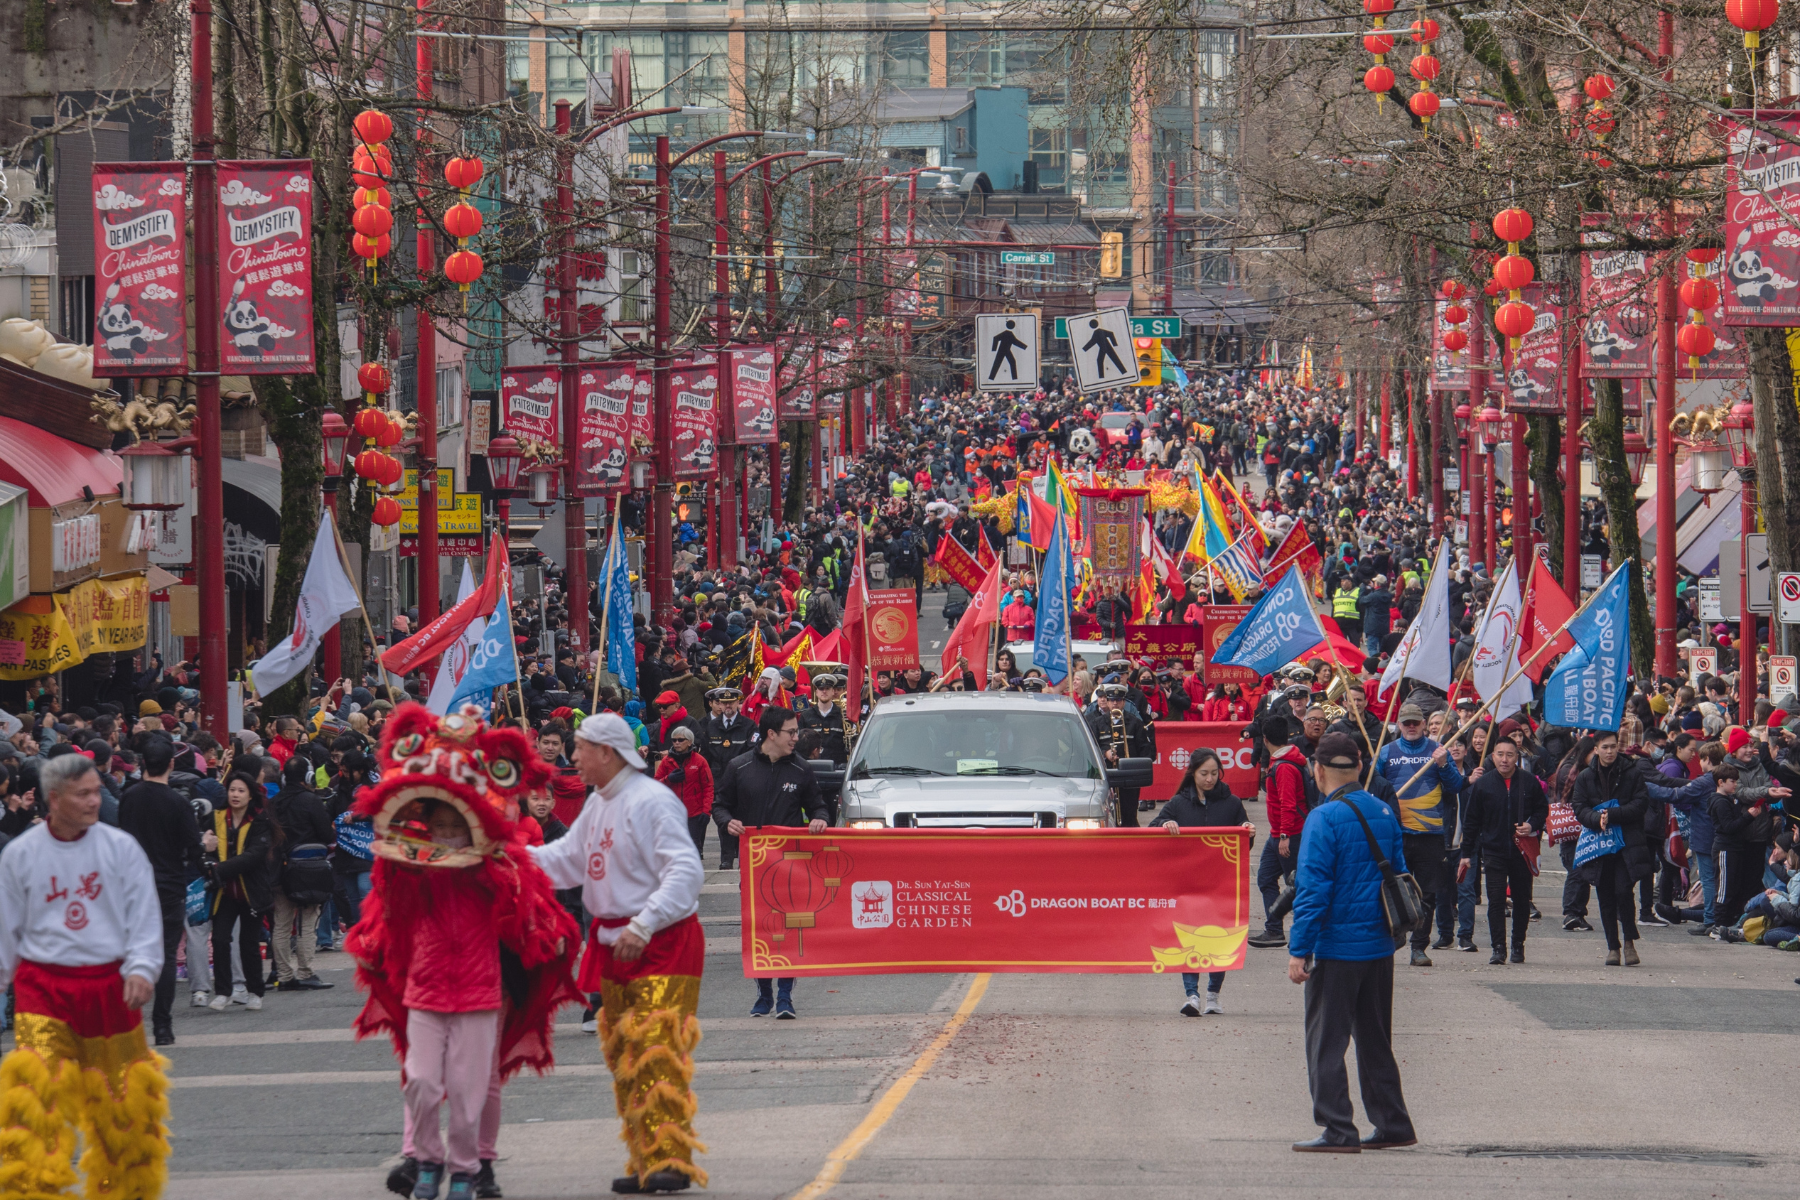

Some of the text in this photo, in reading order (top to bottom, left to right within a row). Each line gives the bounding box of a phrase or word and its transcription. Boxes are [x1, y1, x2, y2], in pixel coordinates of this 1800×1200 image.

[110, 214, 169, 246] DEMYSTIFY
[235, 210, 295, 242] DEMYSTIFY
[101, 244, 180, 278] Chinatown
[227, 241, 307, 274] Chinatown
[1039, 254, 1050, 263] St
[120, 263, 180, 288] 輕鬆遊華埠
[246, 261, 305, 285] 輕鬆遊華埠
[1728, 305, 1800, 314] VANCOUVER-CHINATOWN.C
[1151, 320, 1171, 334] St
[98, 357, 181, 365] VANCOUVER-CHINATOWN.COM
[227, 354, 310, 363] VANCOUVER-CHINATOWN.COM
[443, 521, 480, 530] TRAVEL
[1599, 656, 1615, 726] PACIFIC
[1583, 678, 1597, 725] BOAT
[1216, 747, 1254, 769] BC
[340, 827, 375, 840] VANCOU
[896, 892, 972, 902] CLASSICAL
[1031, 898, 1088, 908] DRAGON
[1091, 898, 1126, 908] BOAT
[1128, 898, 1145, 908] BC
[1148, 898, 1177, 909] 龍舟會
[896, 905, 972, 915] CHINESE
[896, 917, 972, 928] GARDEN
